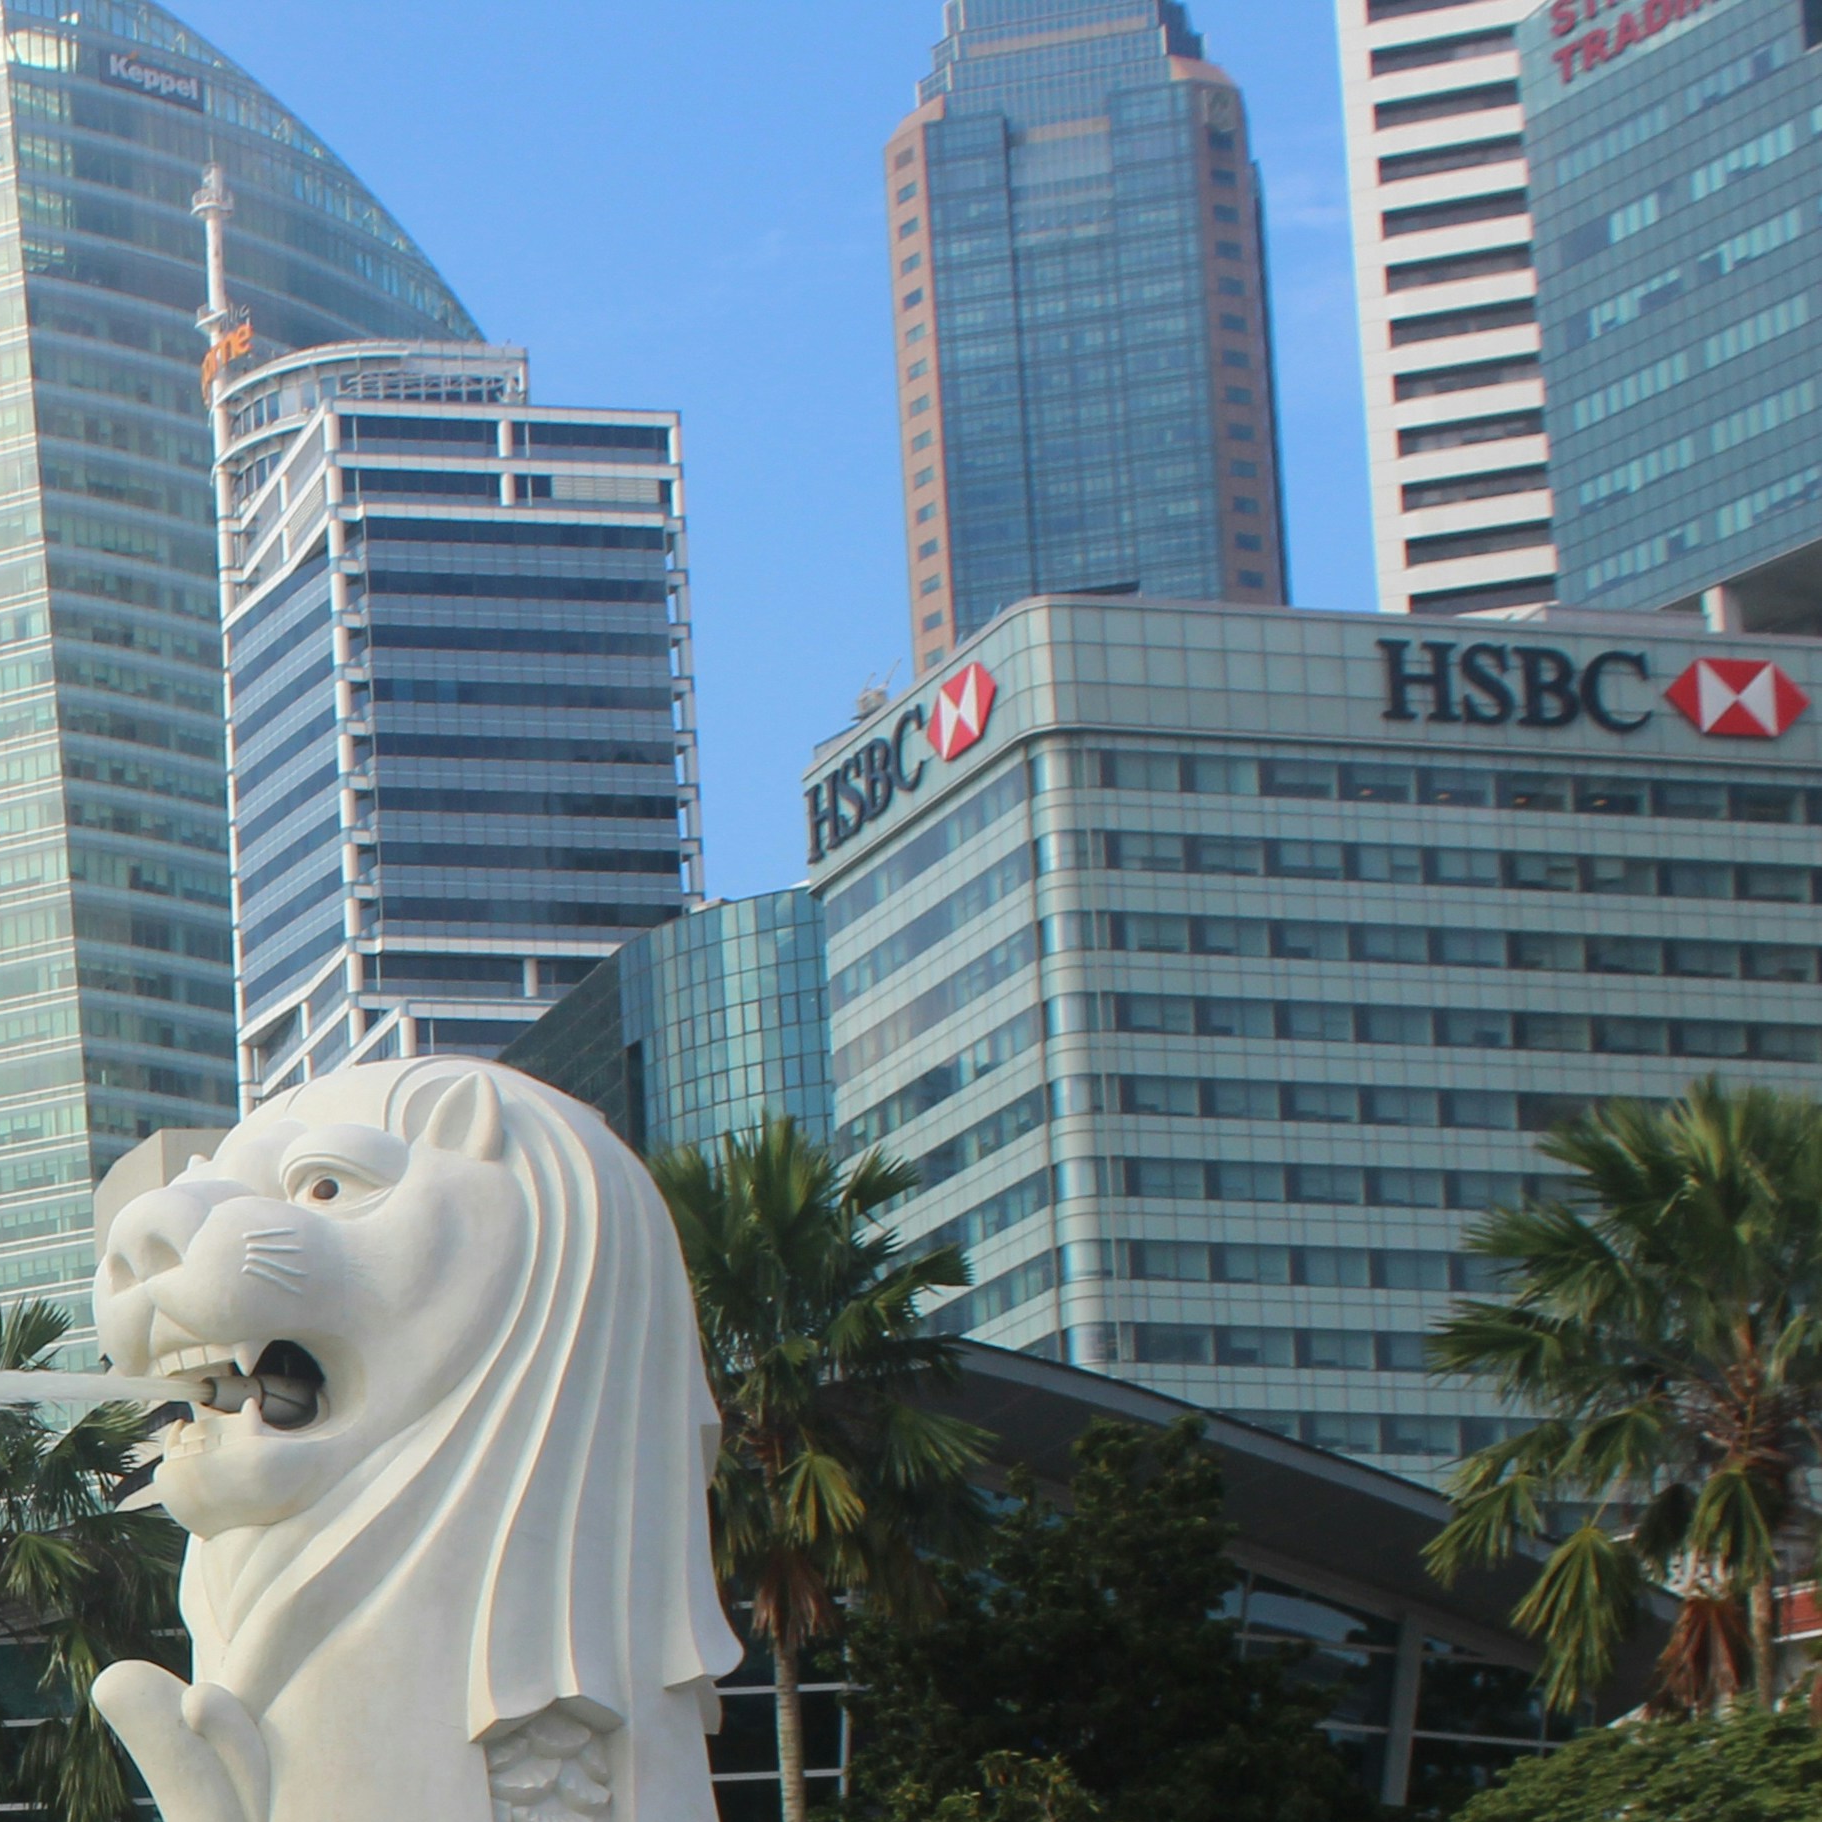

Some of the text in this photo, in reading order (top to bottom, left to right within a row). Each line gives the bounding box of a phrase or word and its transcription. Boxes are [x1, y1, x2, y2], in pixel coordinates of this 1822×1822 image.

[110, 54, 198, 100] Keppel
[1375, 638, 1653, 733] HSBC
[804, 703, 925, 865] HSBC
